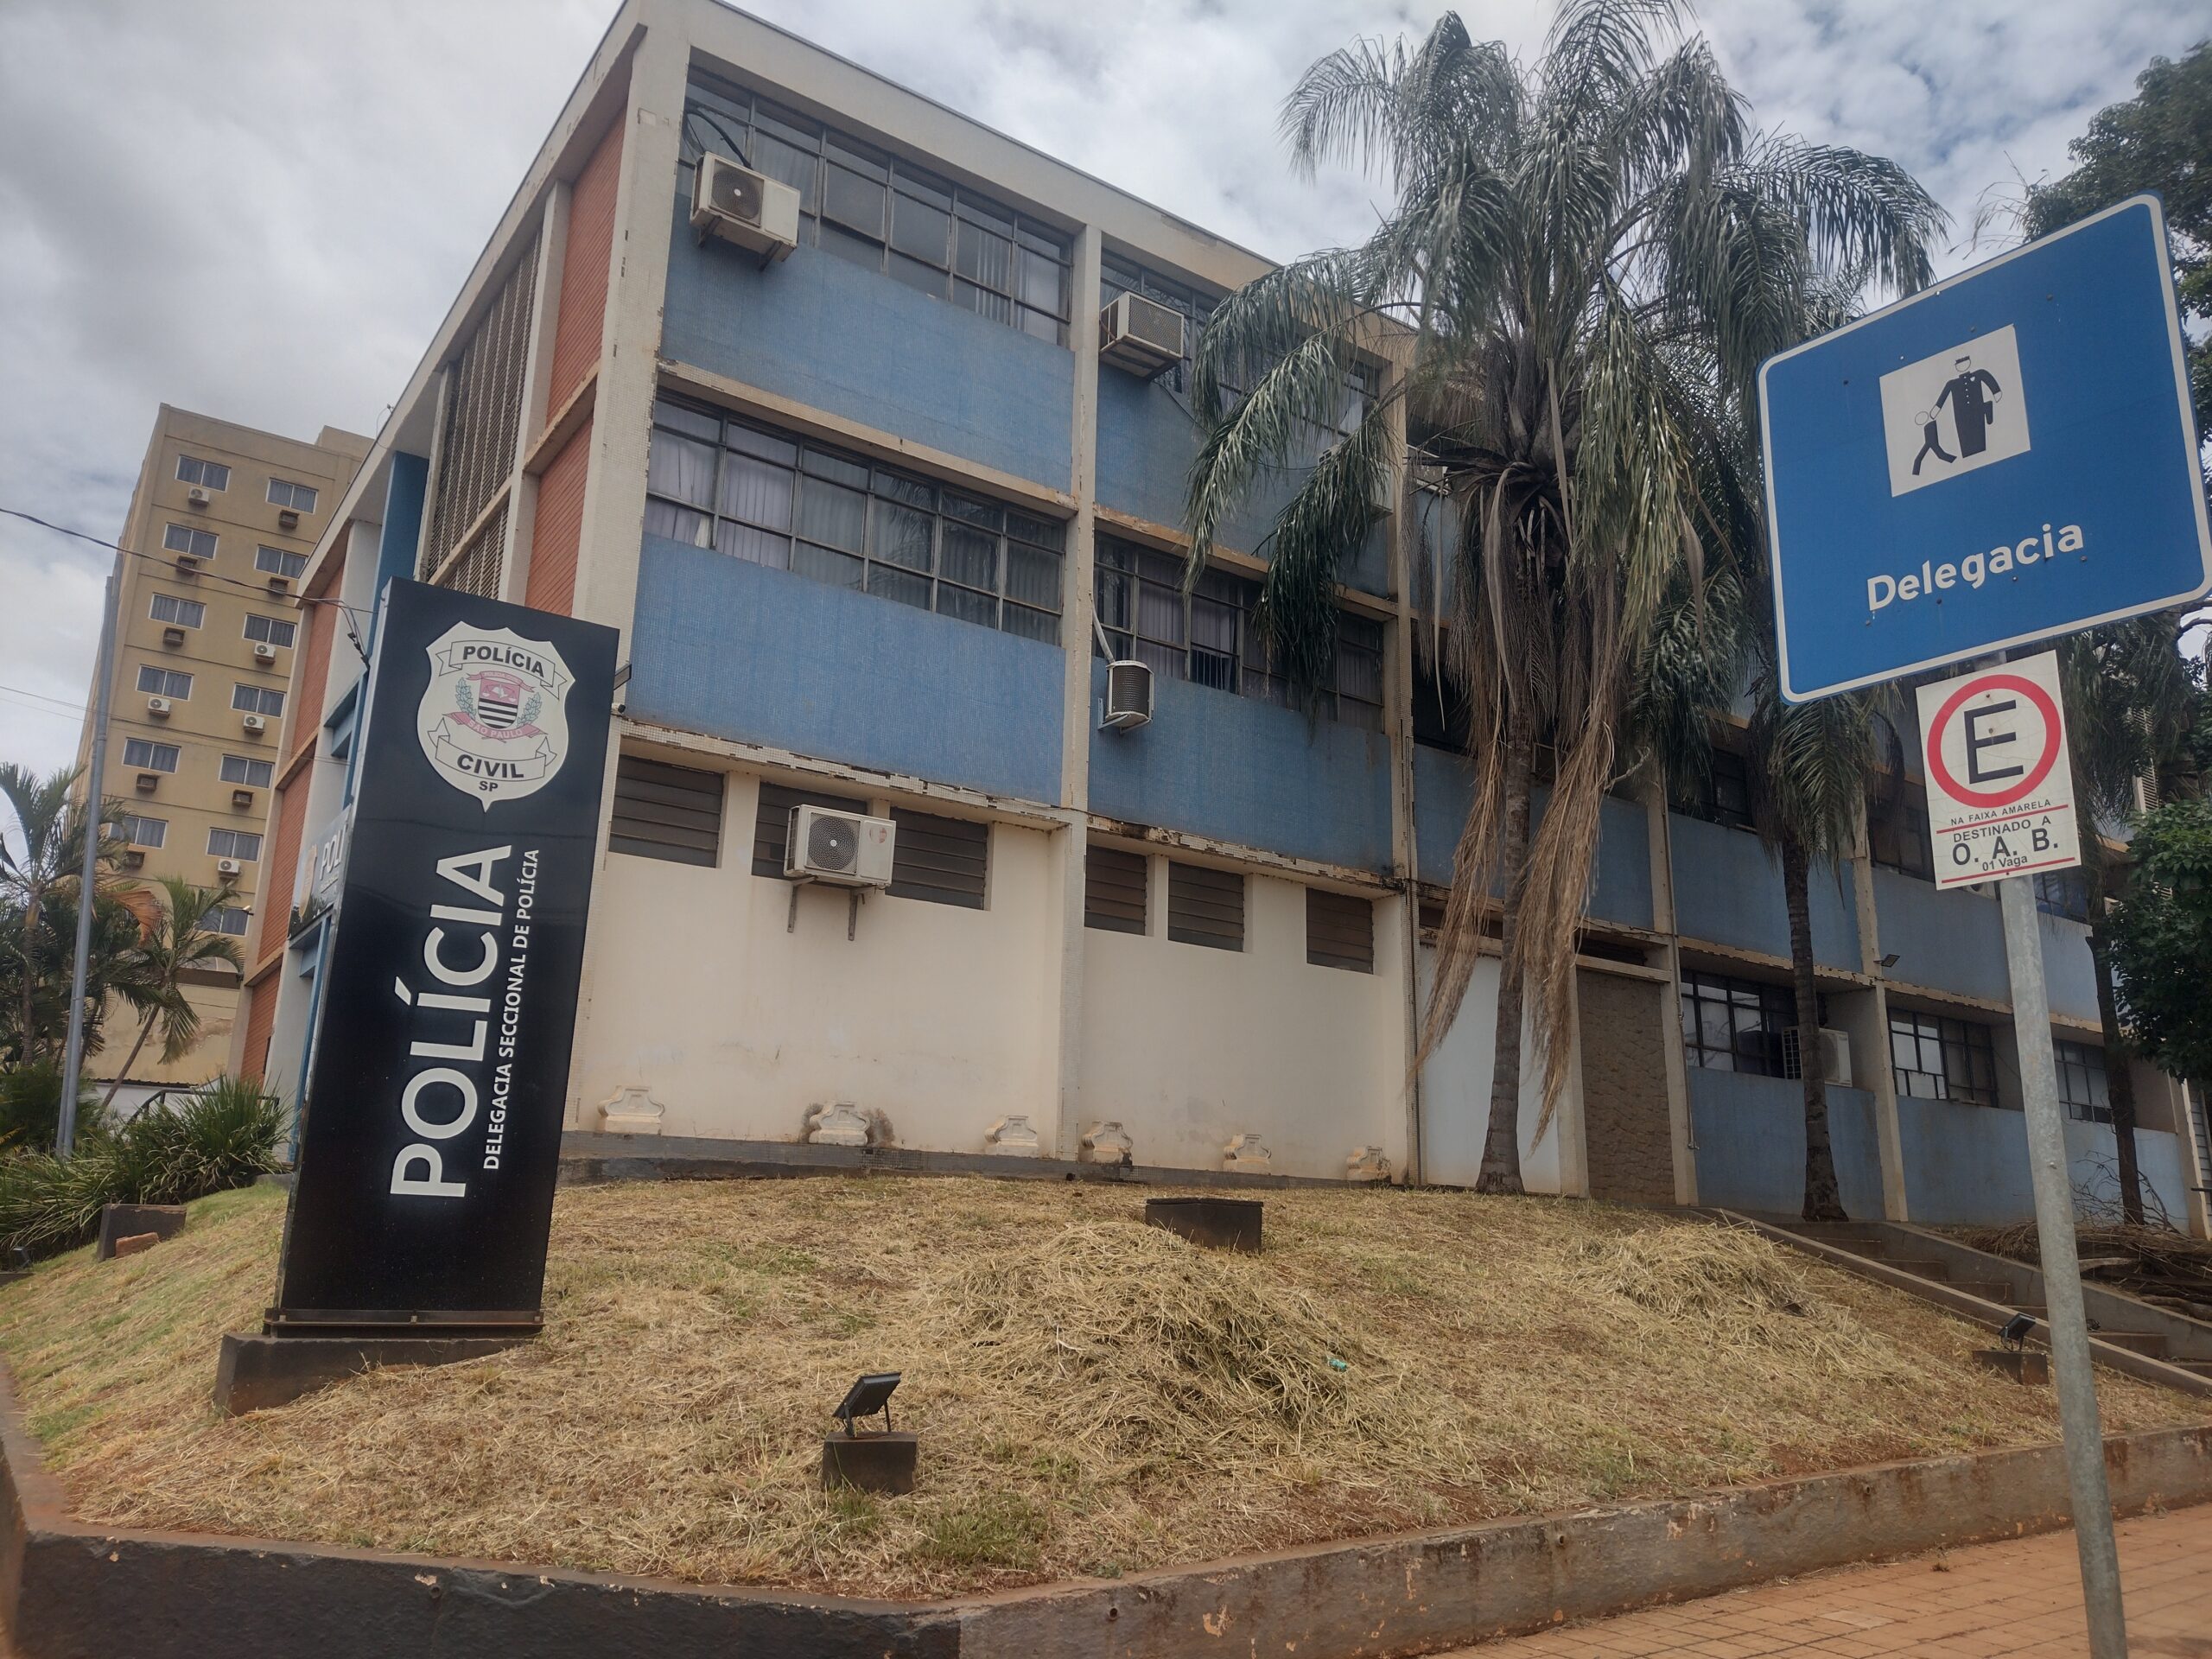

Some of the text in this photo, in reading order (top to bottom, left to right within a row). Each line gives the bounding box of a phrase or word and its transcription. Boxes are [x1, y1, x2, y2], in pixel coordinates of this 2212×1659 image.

[1867, 523, 2084, 611] Delegacia
[463, 645, 544, 678] POLÍCIA
[491, 728, 523, 739] PAULO
[1964, 699, 2024, 785] E
[457, 754, 524, 779] CIVIL
[479, 780, 499, 791] SP
[1950, 798, 2051, 826] NA FAIXA AMARELA
[1954, 815, 2051, 842] DESTINADO A
[1982, 855, 2028, 871] 01 Vaga
[390, 845, 512, 1198] POLÍCIA
[483, 849, 540, 1169] DELEGACIA SECCIONAL DE POLÍCIA
